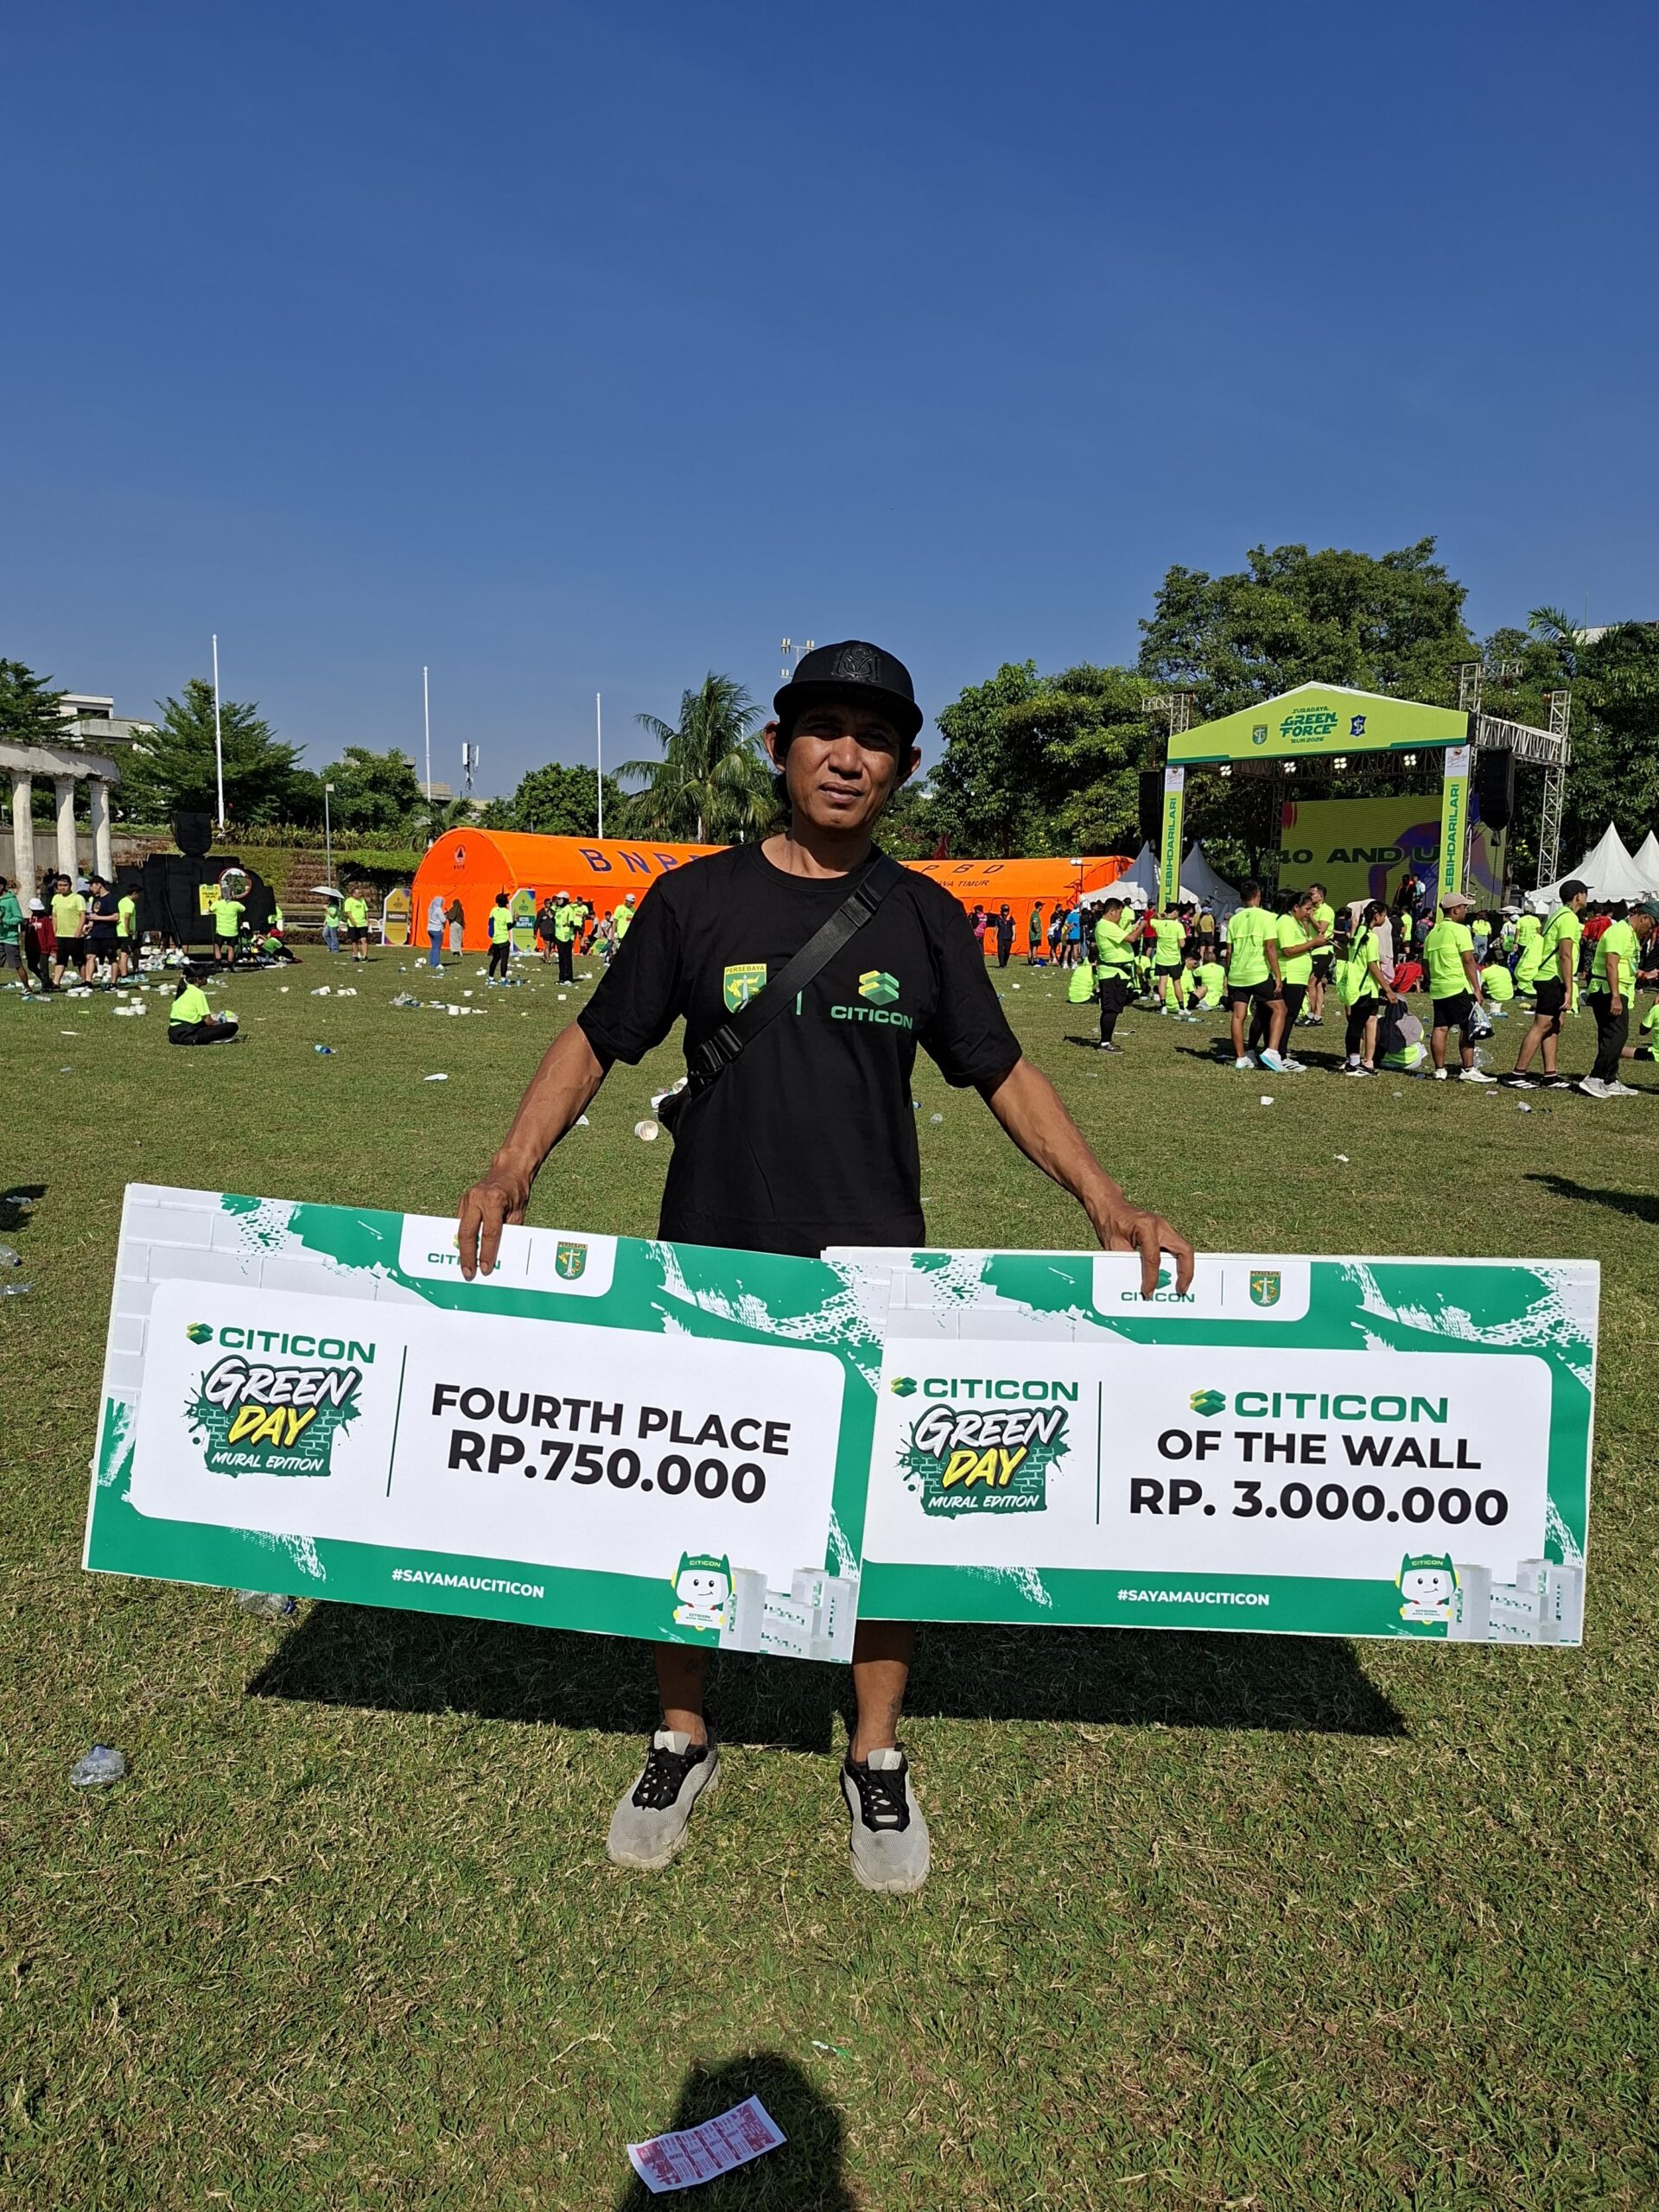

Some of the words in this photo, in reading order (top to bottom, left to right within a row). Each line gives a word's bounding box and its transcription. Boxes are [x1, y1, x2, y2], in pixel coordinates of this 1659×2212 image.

[1280, 723, 1338, 737] FORCE
[1281, 712, 1338, 726] GREEN
[1326, 847, 1402, 863] AND
[1413, 845, 1440, 862] U
[1445, 784, 1459, 893] LEBIHDARILARI
[830, 1005, 912, 1029] CITICON
[427, 1253, 501, 1270] CITI
[1121, 1292, 1195, 1303] CICON
[219, 1327, 376, 1363] CITICON
[204, 1357, 357, 1411] GREEN
[924, 1378, 1078, 1402] CITICON
[431, 1383, 624, 1436] FOURTH
[638, 1406, 791, 1456] PLACE
[1234, 1391, 1449, 1423] CITICON
[227, 1405, 317, 1446] DAY
[914, 1407, 1063, 1458] GREEN
[211, 1452, 261, 1468] MURAL
[266, 1455, 324, 1471] EDITION
[1157, 1428, 1222, 1460] OF
[1234, 1431, 1327, 1465] THE
[1341, 1434, 1482, 1470] WALL
[448, 1429, 766, 1503] RP.750.000
[942, 1446, 1027, 1488] DAY
[928, 1496, 978, 1509] MURAL
[982, 1494, 1039, 1508] EDITION
[1129, 1478, 1216, 1516] RP.
[1232, 1480, 1509, 1526] 3.000.000
[391, 1568, 544, 1599] #SAYAMAUCITICON
[1116, 1589, 1269, 1605] #SAYAMAUCITICON
